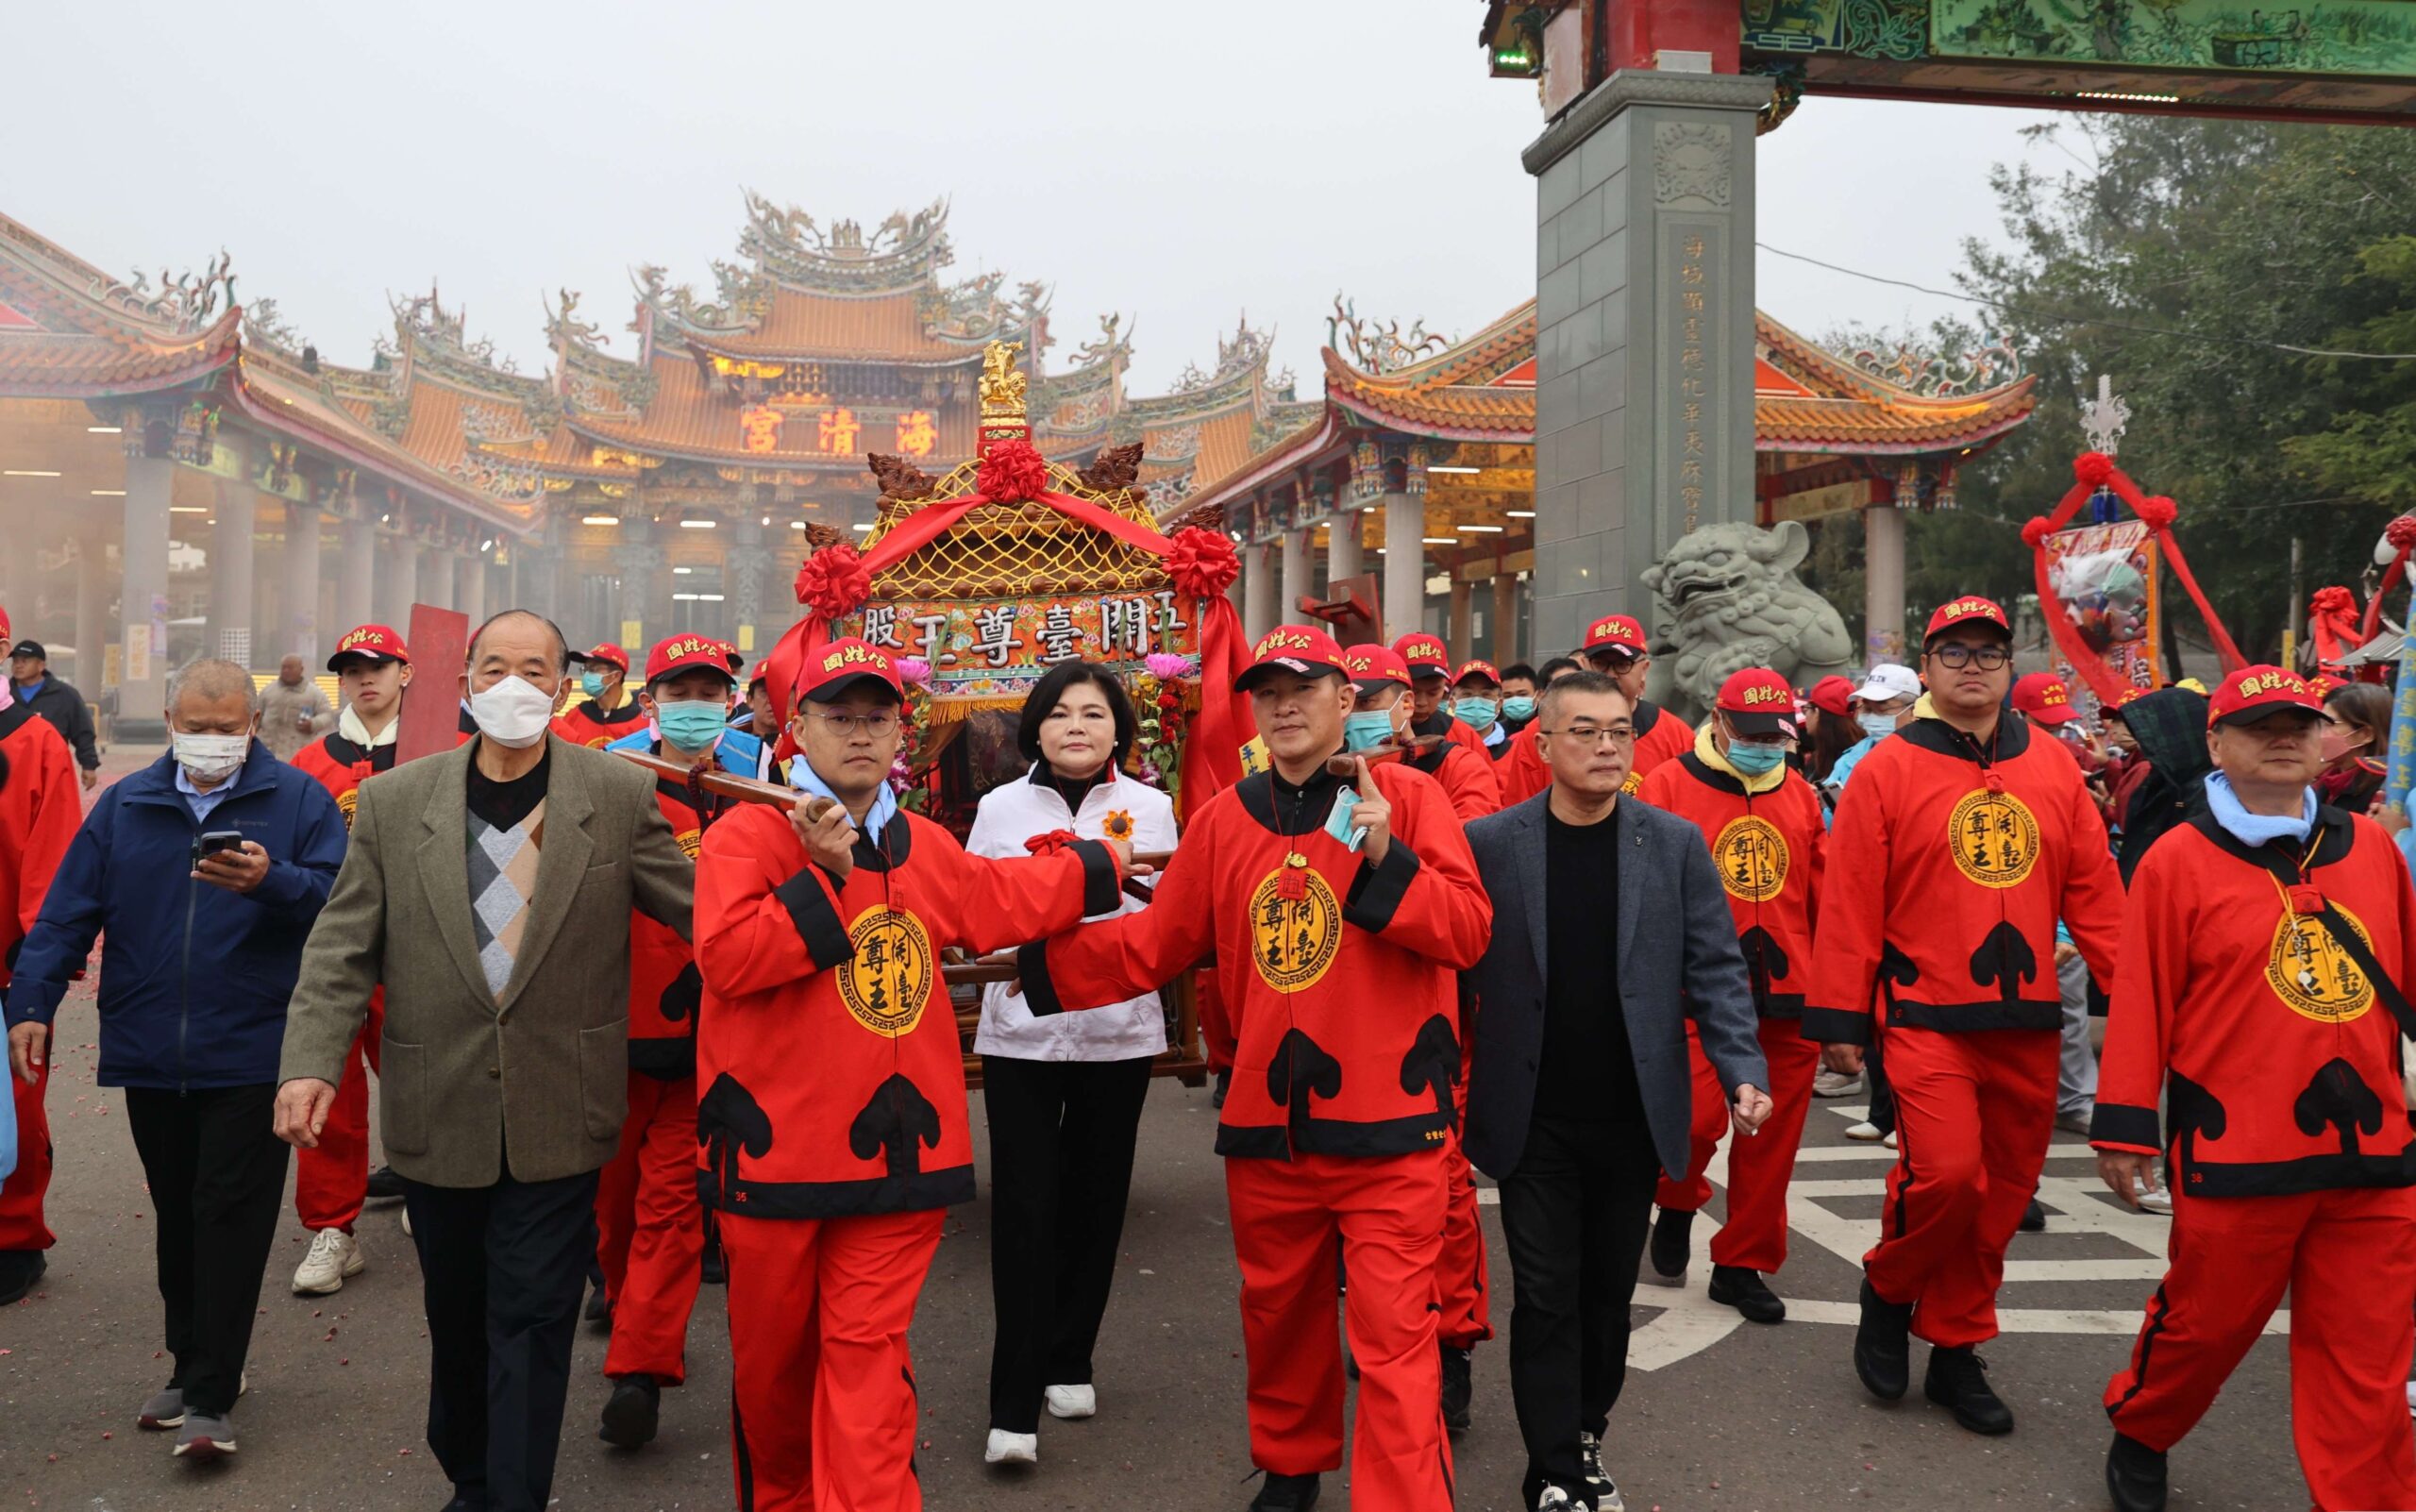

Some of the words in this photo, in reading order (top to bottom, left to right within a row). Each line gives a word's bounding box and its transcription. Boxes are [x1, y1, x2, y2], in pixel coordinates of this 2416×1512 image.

[1944, 600, 1997, 620] 國姓公
[1595, 620, 1633, 639] 國姓公
[666, 638, 718, 661] 國姓公
[1255, 630, 1312, 662] 國姓公
[823, 645, 888, 673] 國姓公
[1743, 684, 1788, 705] 國姓公
[2238, 671, 2305, 698] 國姓公
